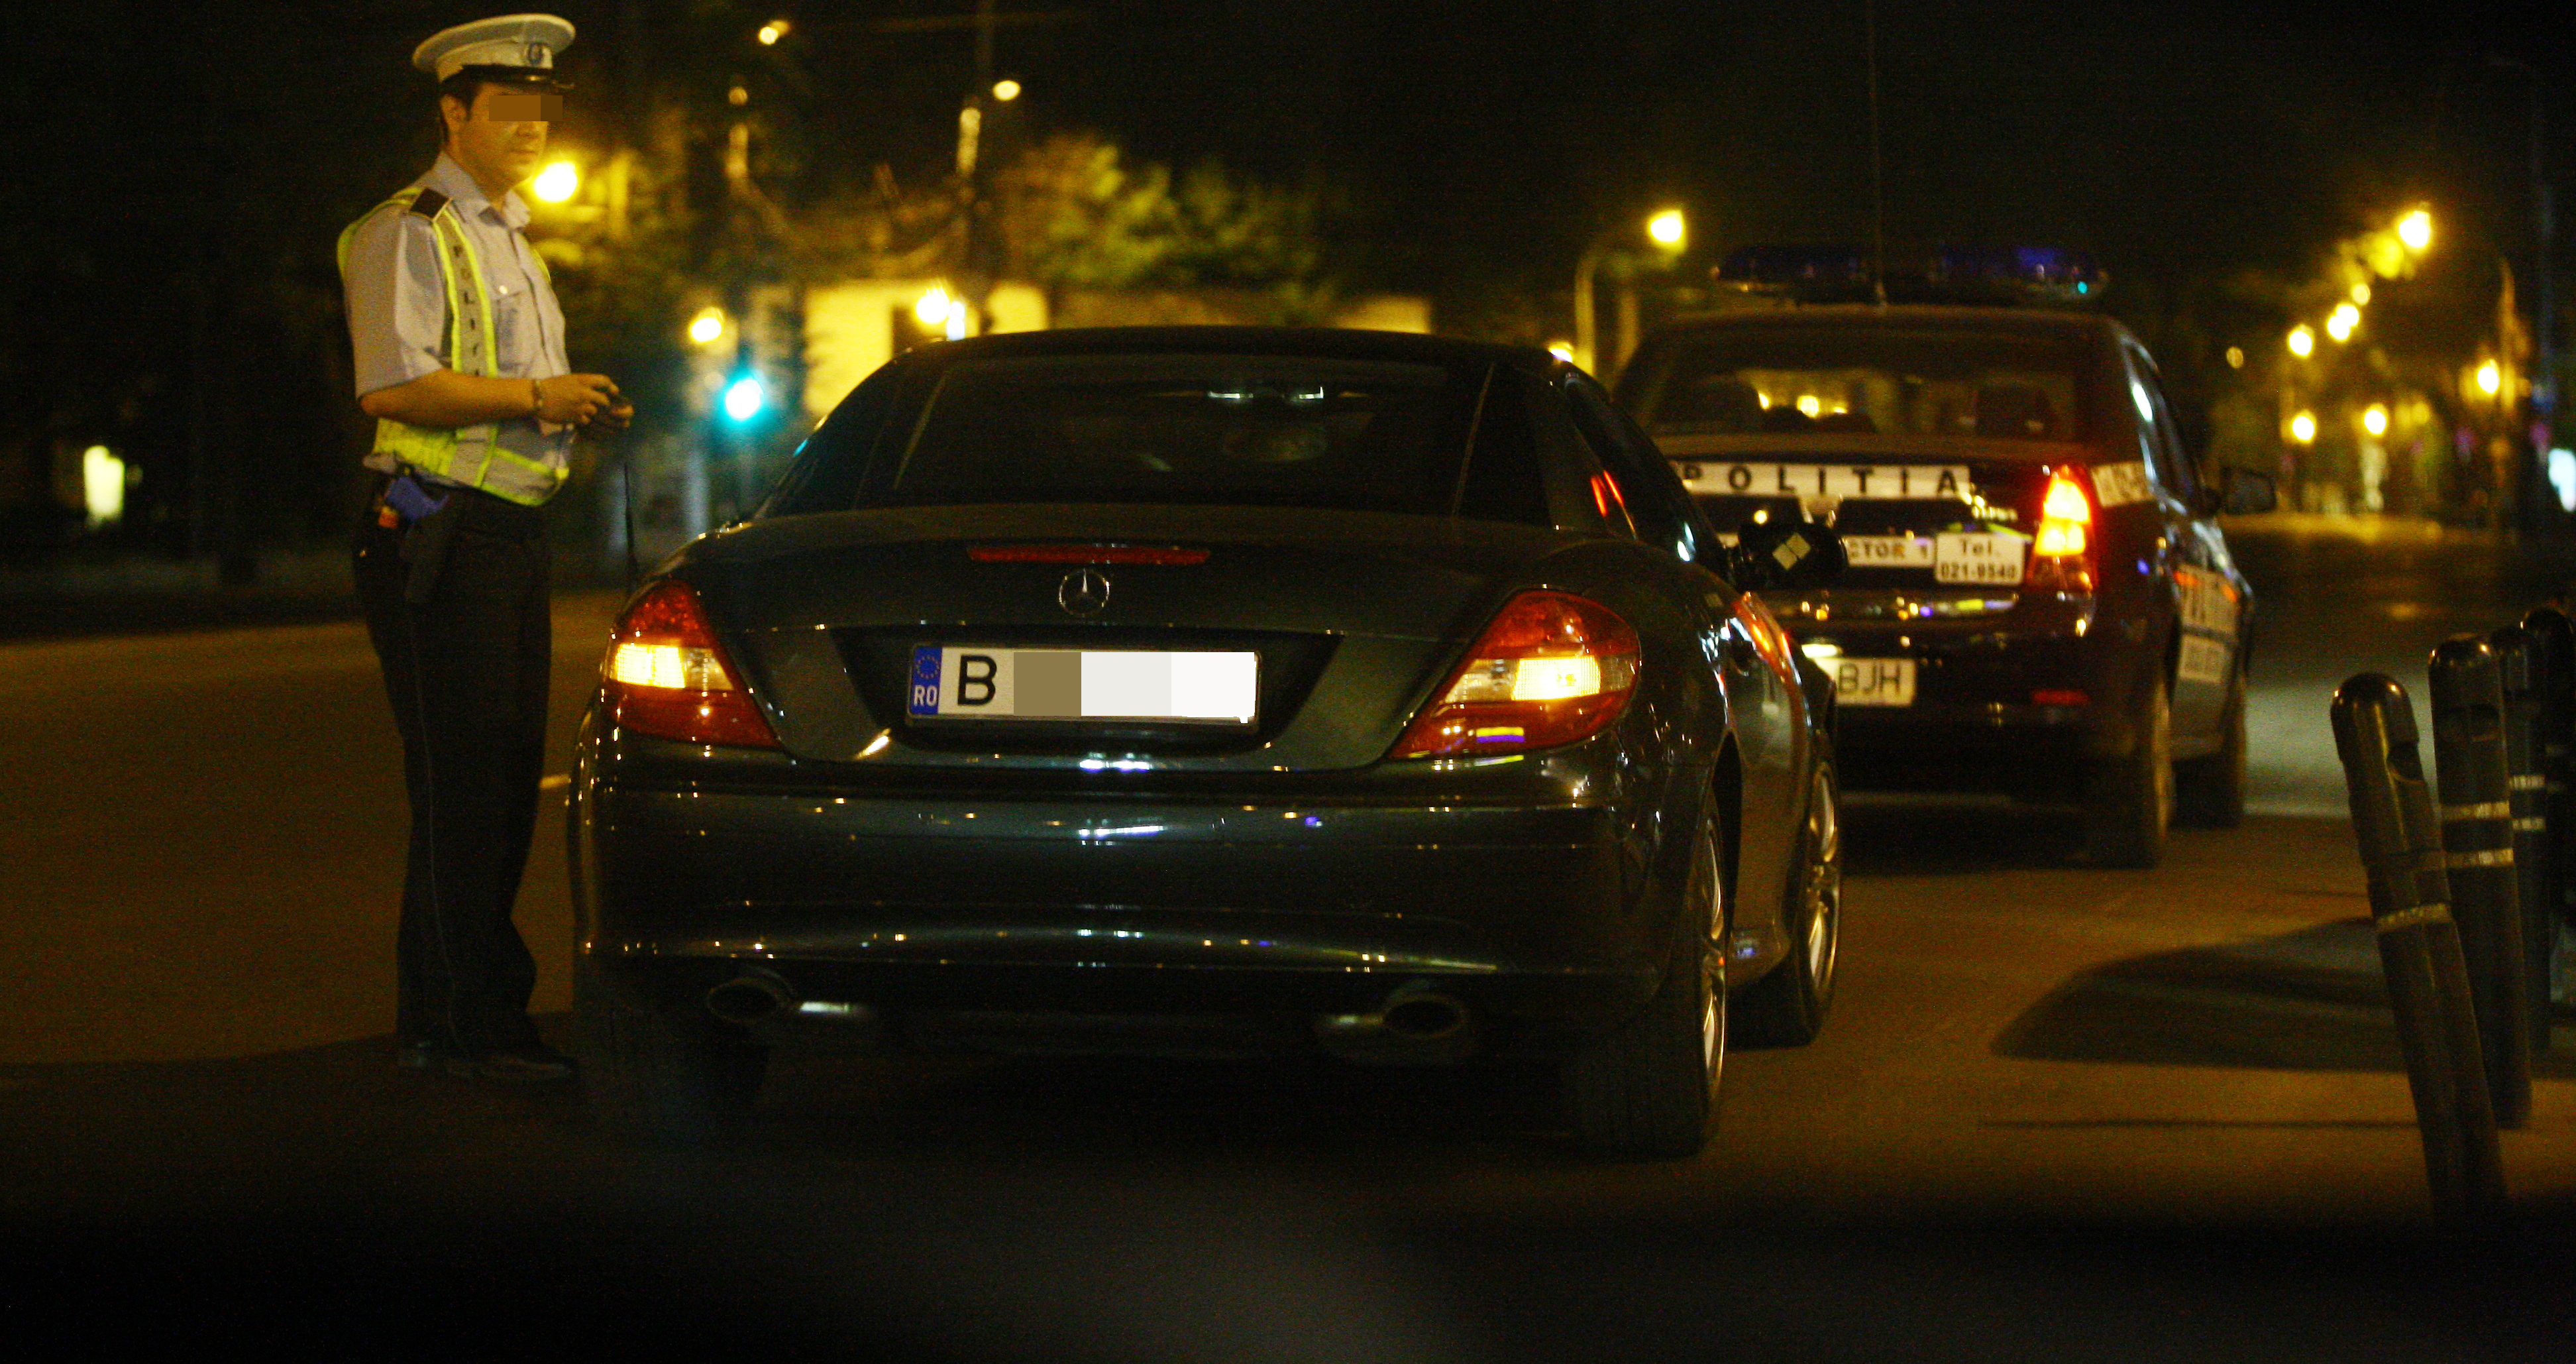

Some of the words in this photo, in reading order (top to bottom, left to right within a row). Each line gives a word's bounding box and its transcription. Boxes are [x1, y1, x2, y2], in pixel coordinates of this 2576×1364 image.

[1682, 465, 1959, 494] POLITIA
[1850, 540, 1907, 559] CTOR
[957, 654, 998, 707] B
[1839, 663, 1902, 695] BJH
[914, 685, 938, 707] RO
